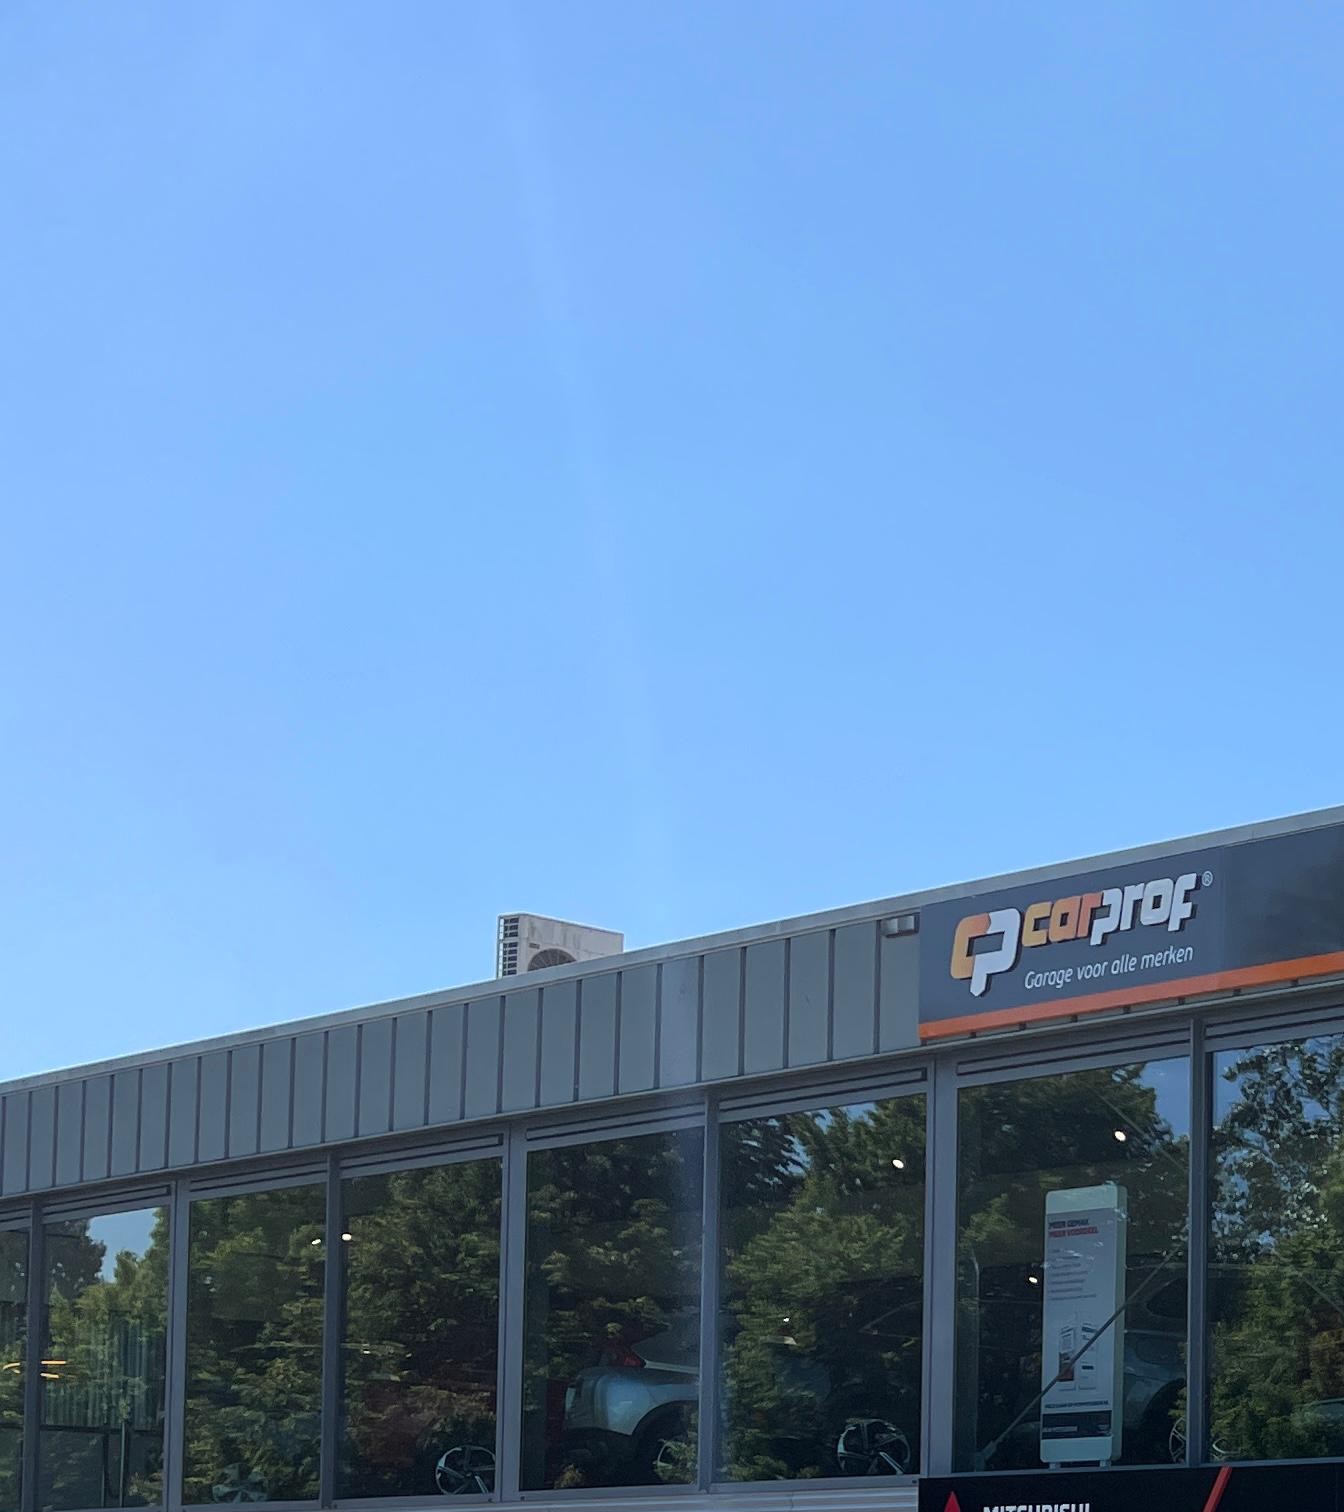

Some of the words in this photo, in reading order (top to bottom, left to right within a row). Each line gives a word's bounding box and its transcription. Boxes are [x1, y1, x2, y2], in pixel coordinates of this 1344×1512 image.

[1024, 969, 1073, 990] Garage
[1077, 960, 1108, 979] voor
[1112, 953, 1137, 976] alle
[1140, 945, 1194, 970] merken
